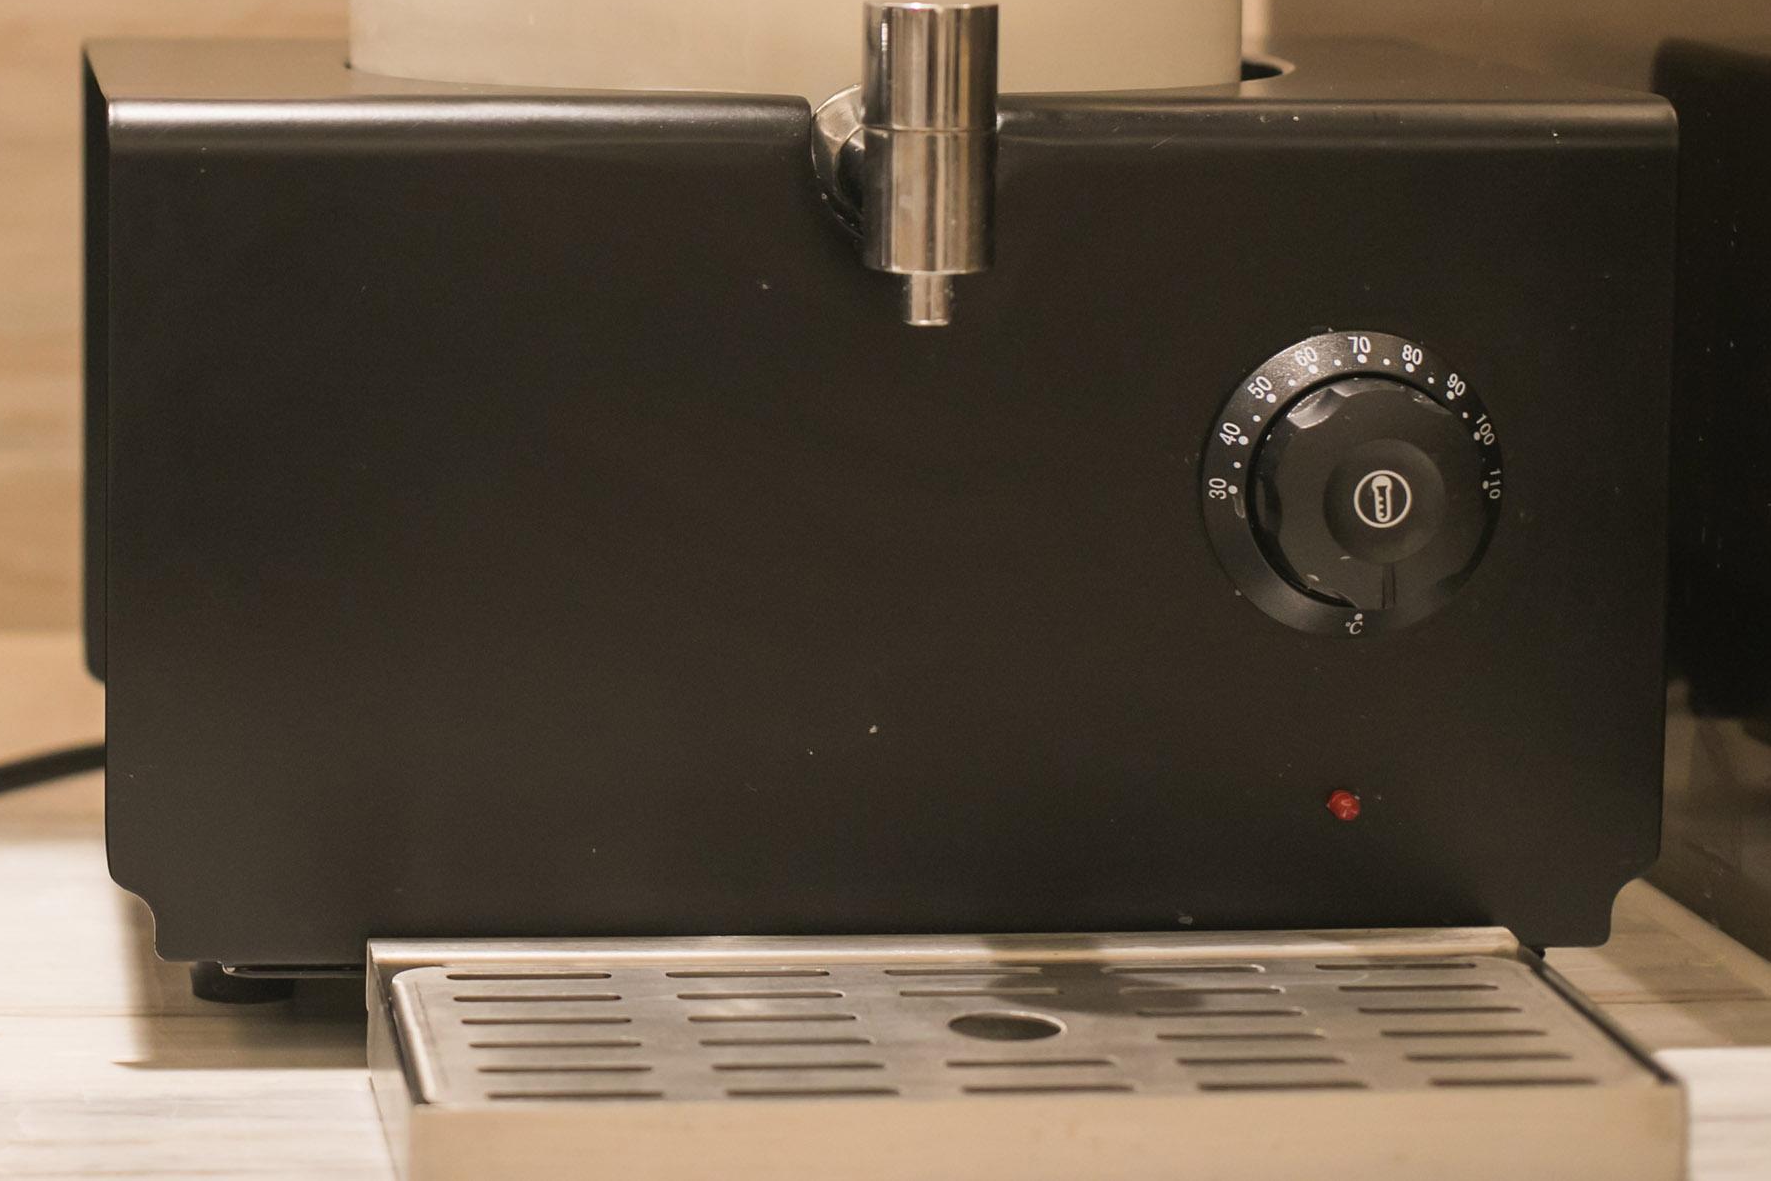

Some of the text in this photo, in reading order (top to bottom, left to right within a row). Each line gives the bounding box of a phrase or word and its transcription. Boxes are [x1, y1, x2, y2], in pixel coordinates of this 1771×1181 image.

[1208, 336, 1501, 500] 30 40 50 60 70 80 90 100 110
